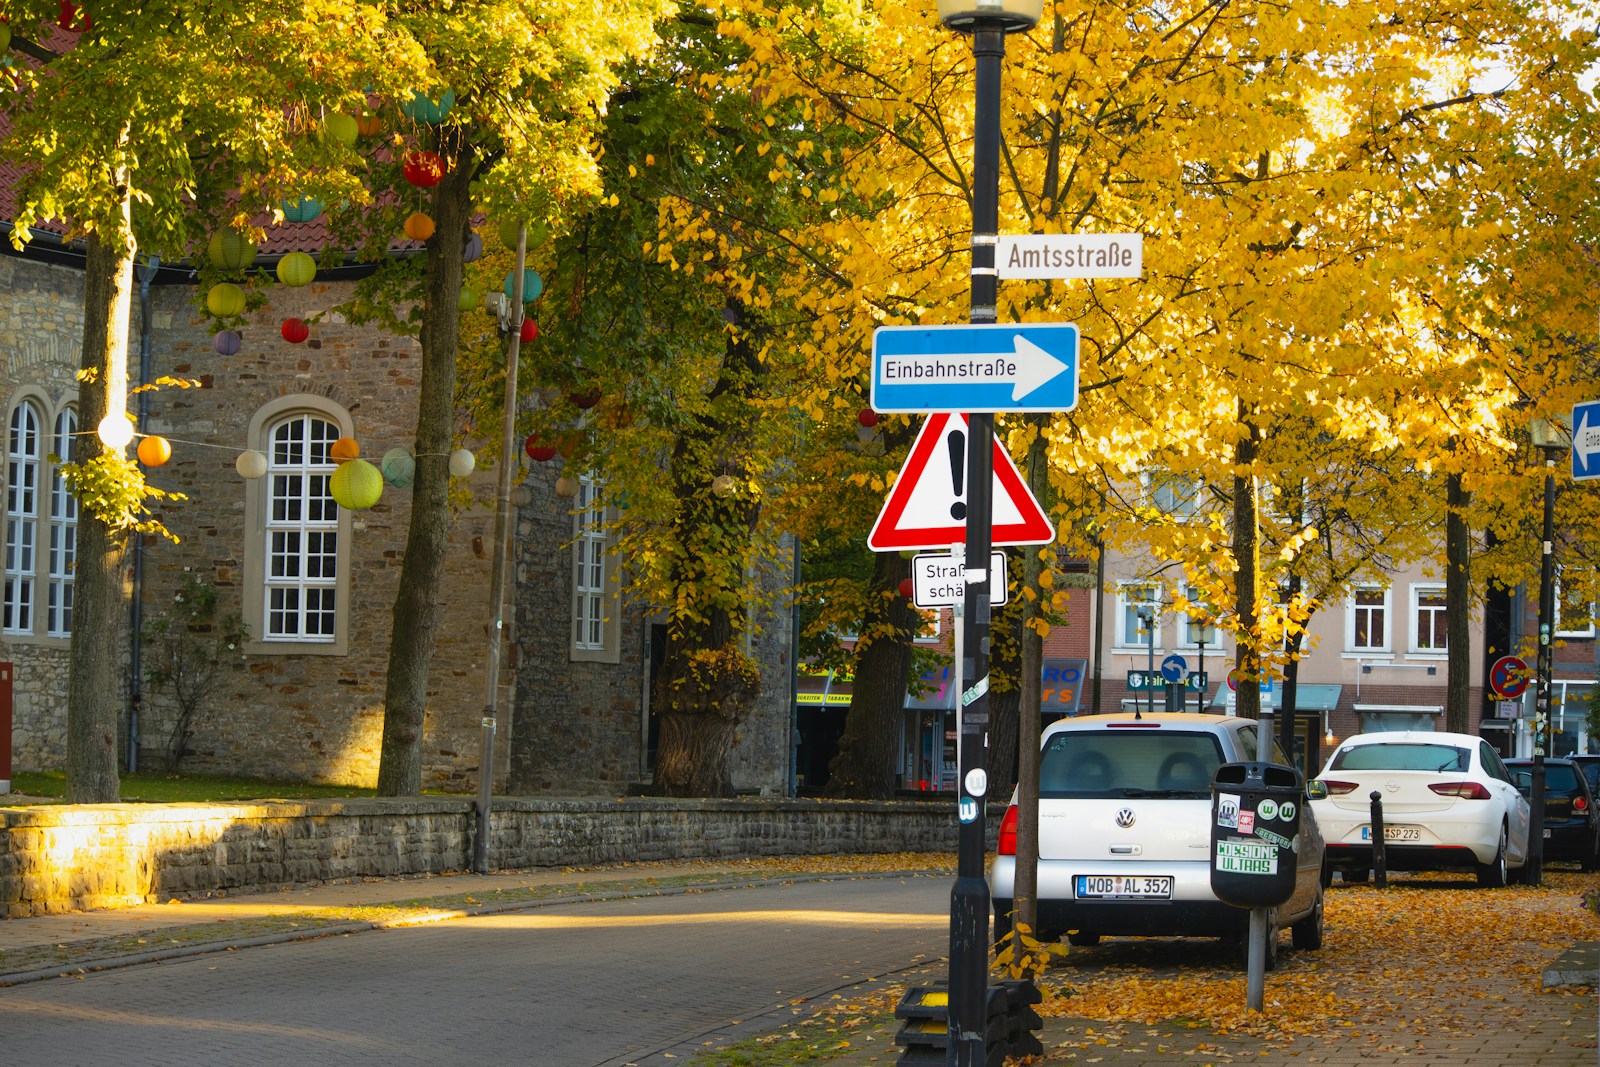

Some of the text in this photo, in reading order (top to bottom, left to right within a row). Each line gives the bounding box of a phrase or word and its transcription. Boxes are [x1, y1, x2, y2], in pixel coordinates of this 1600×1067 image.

[1008, 242, 1132, 268] Amtsstraße
[886, 358, 1017, 378] Einbahnstraße
[926, 563, 966, 578] Straß
[929, 583, 964, 598] schä
[1281, 806, 1295, 819] W
[1390, 829, 1420, 839] SP 273
[1217, 842, 1279, 860] COESIONE
[1222, 857, 1270, 873] ULTRAS
[1088, 878, 1114, 893] WOB
[1123, 878, 1141, 894] AL
[1143, 878, 1170, 894] 352
